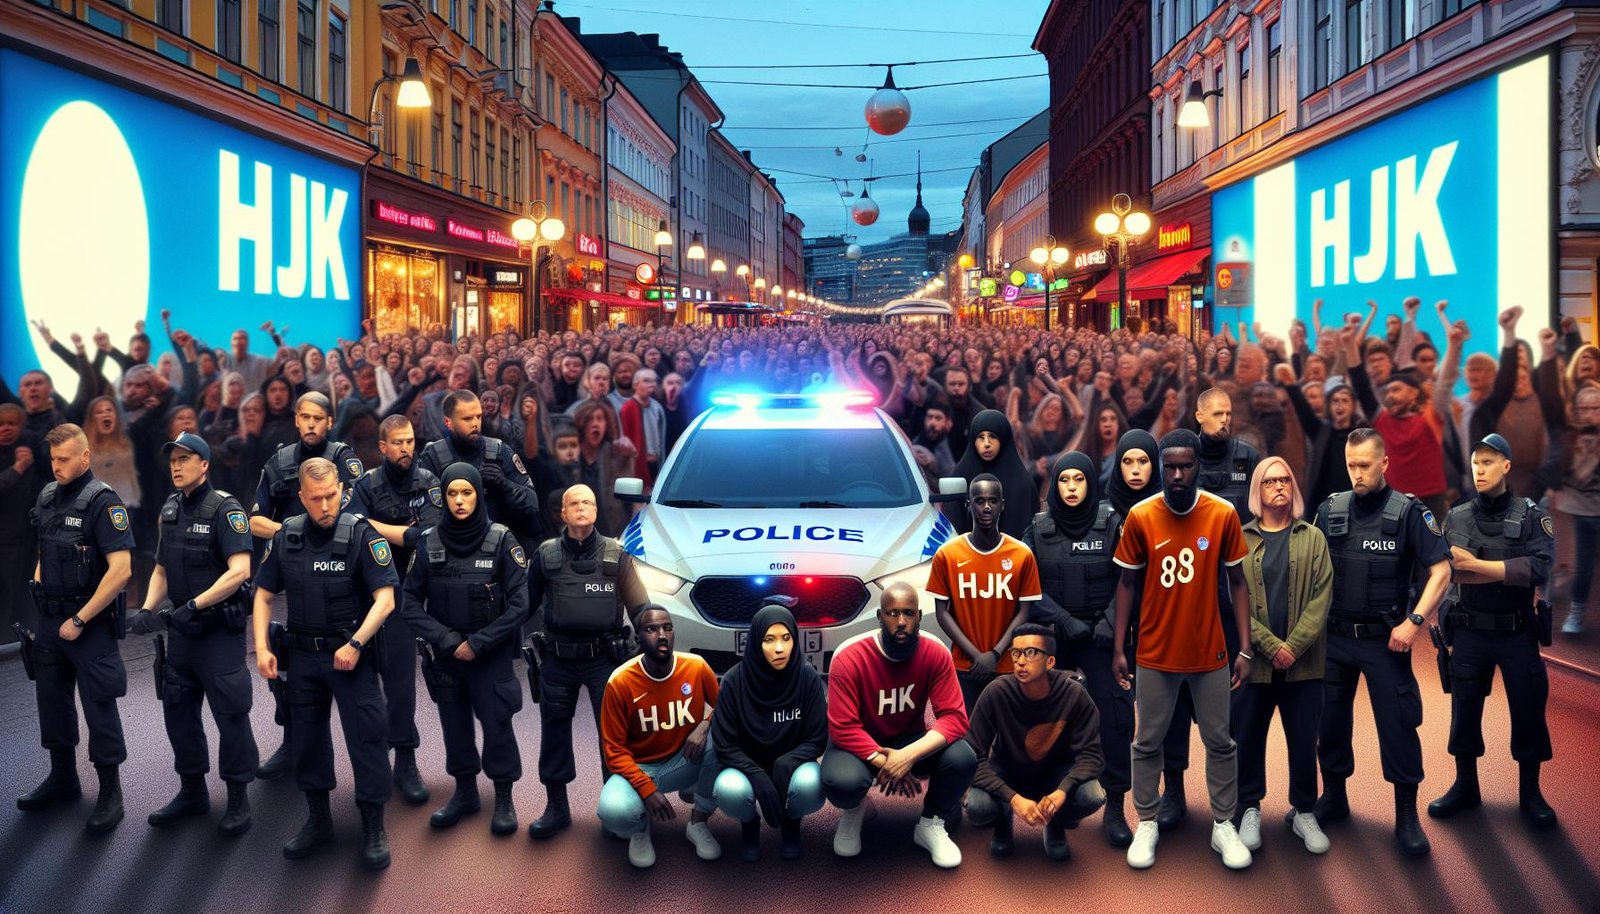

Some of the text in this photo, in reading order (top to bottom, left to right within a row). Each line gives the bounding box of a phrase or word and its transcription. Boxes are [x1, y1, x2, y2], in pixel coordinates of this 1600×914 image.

[218, 148, 351, 301] HJK
[1311, 139, 1459, 288] HJK
[702, 525, 864, 544] POLICE
[1160, 547, 1195, 588] 88
[958, 572, 1014, 601] HJK
[638, 696, 696, 733] HJK
[878, 683, 916, 717] HK
